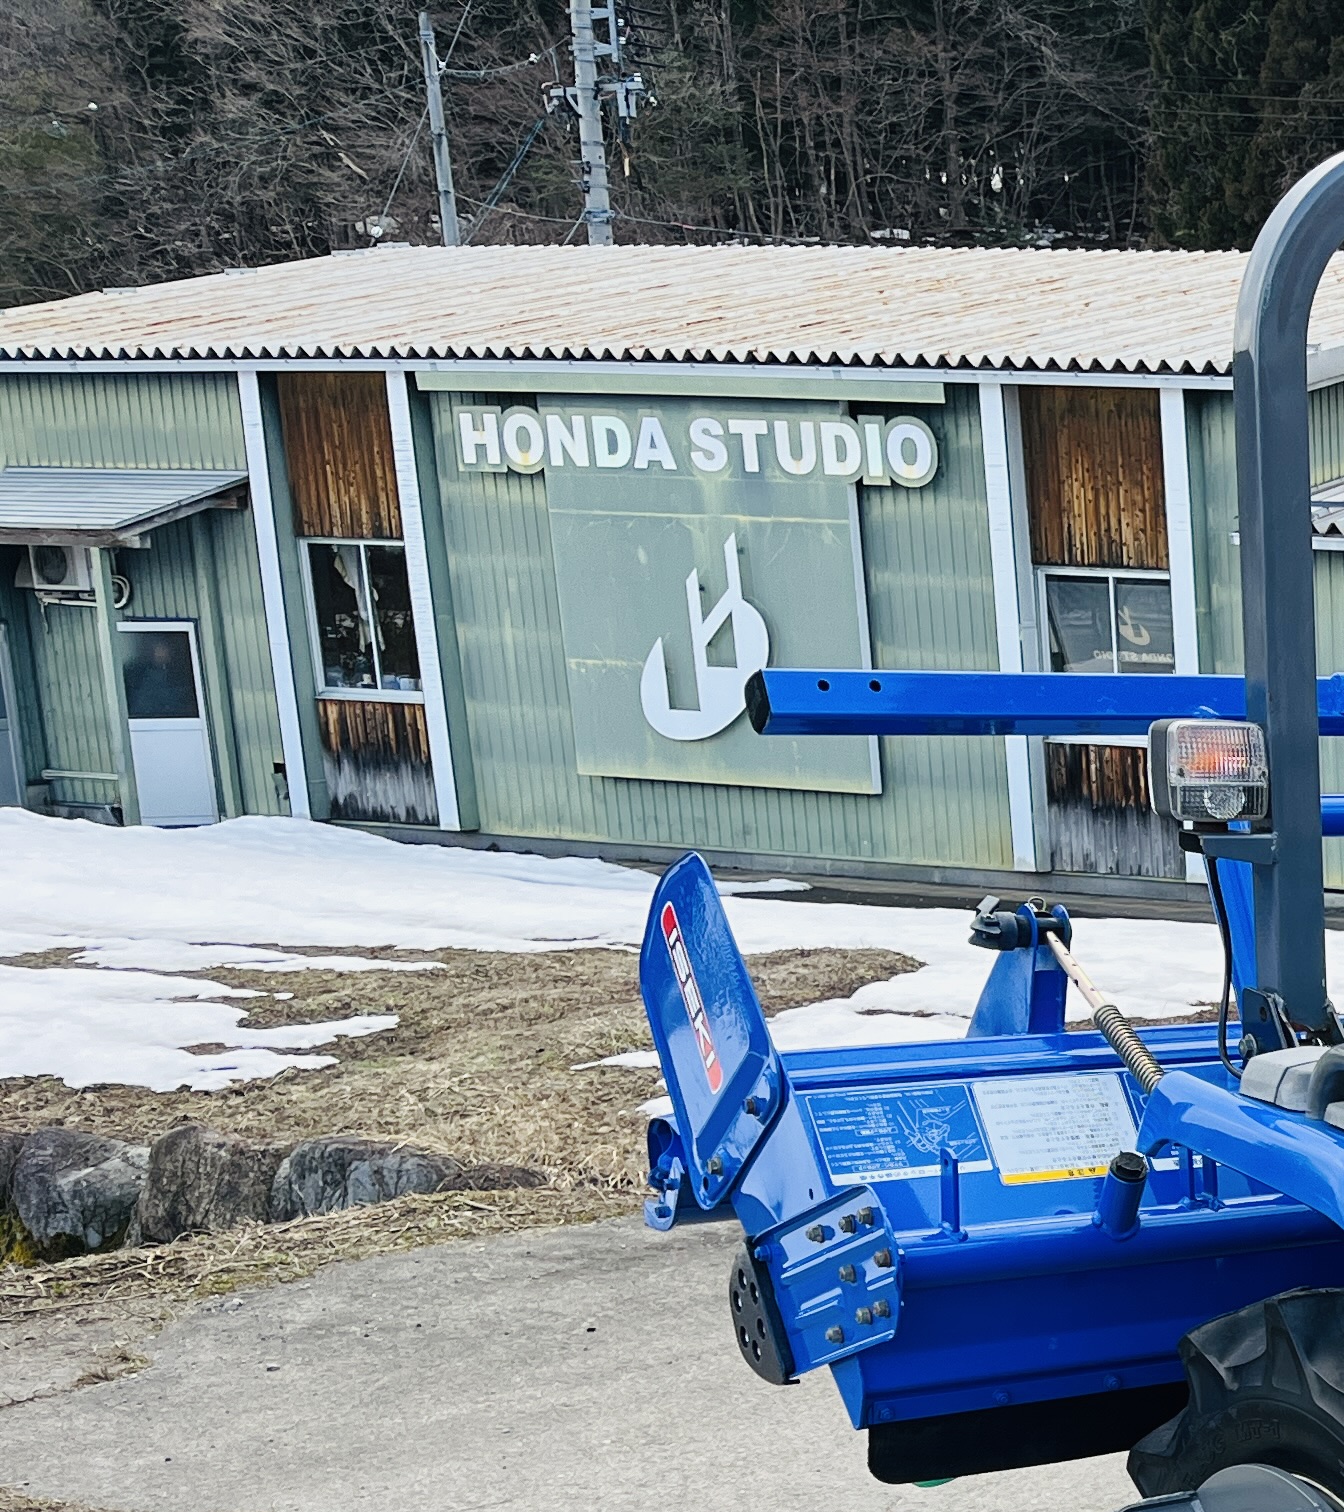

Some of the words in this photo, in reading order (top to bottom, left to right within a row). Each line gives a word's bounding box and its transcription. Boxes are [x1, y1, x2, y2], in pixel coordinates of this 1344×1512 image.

[457, 412, 678, 471] HONDA
[688, 417, 933, 480] STUDIO
[668, 926, 716, 1070] ISEKI
